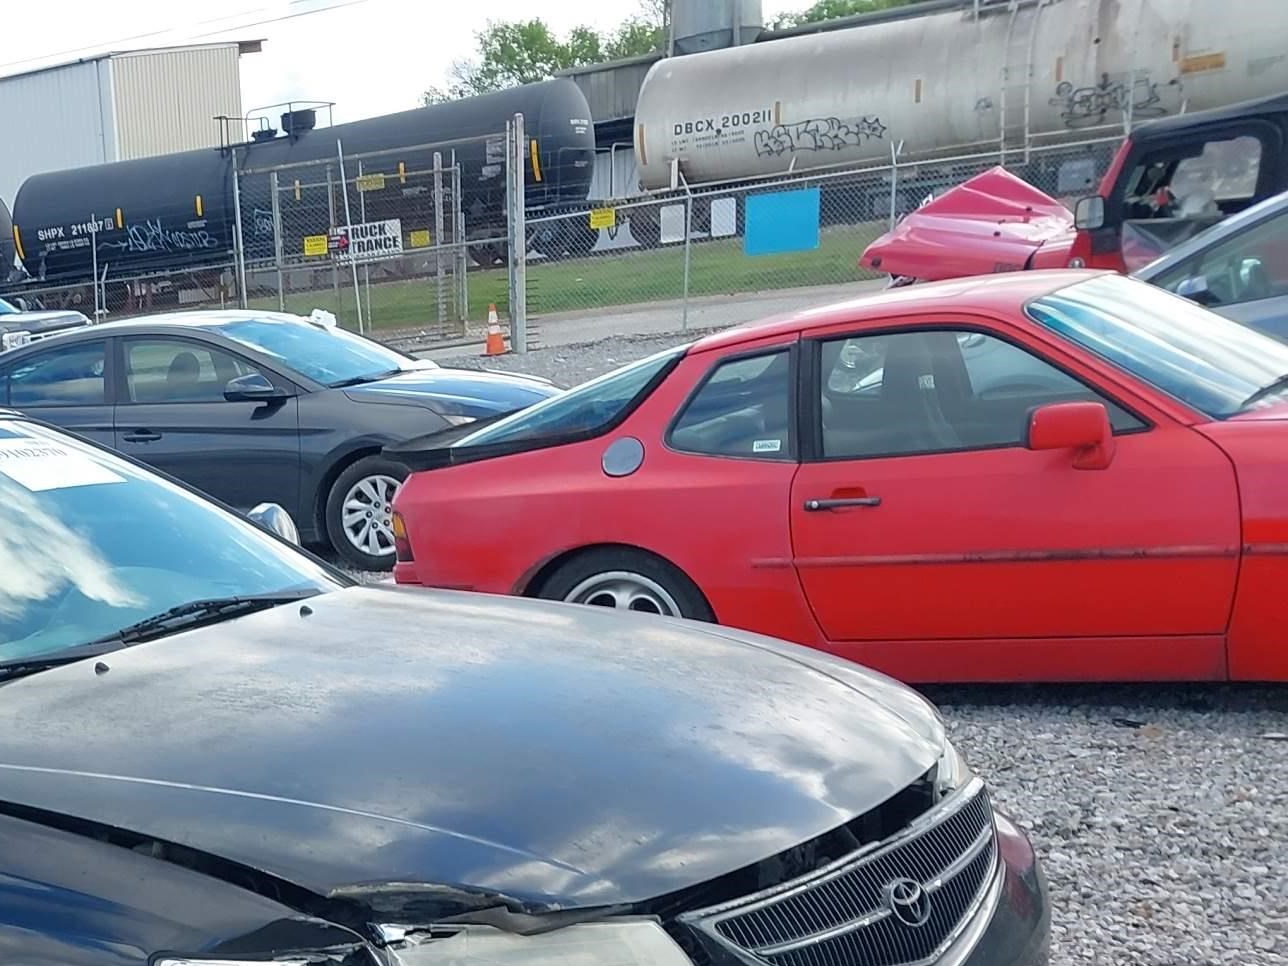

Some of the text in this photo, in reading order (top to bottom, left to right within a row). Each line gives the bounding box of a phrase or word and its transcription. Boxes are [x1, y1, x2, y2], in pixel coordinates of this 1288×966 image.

[674, 109, 772, 136] DBCX 200211
[37, 226, 65, 241] SHPX
